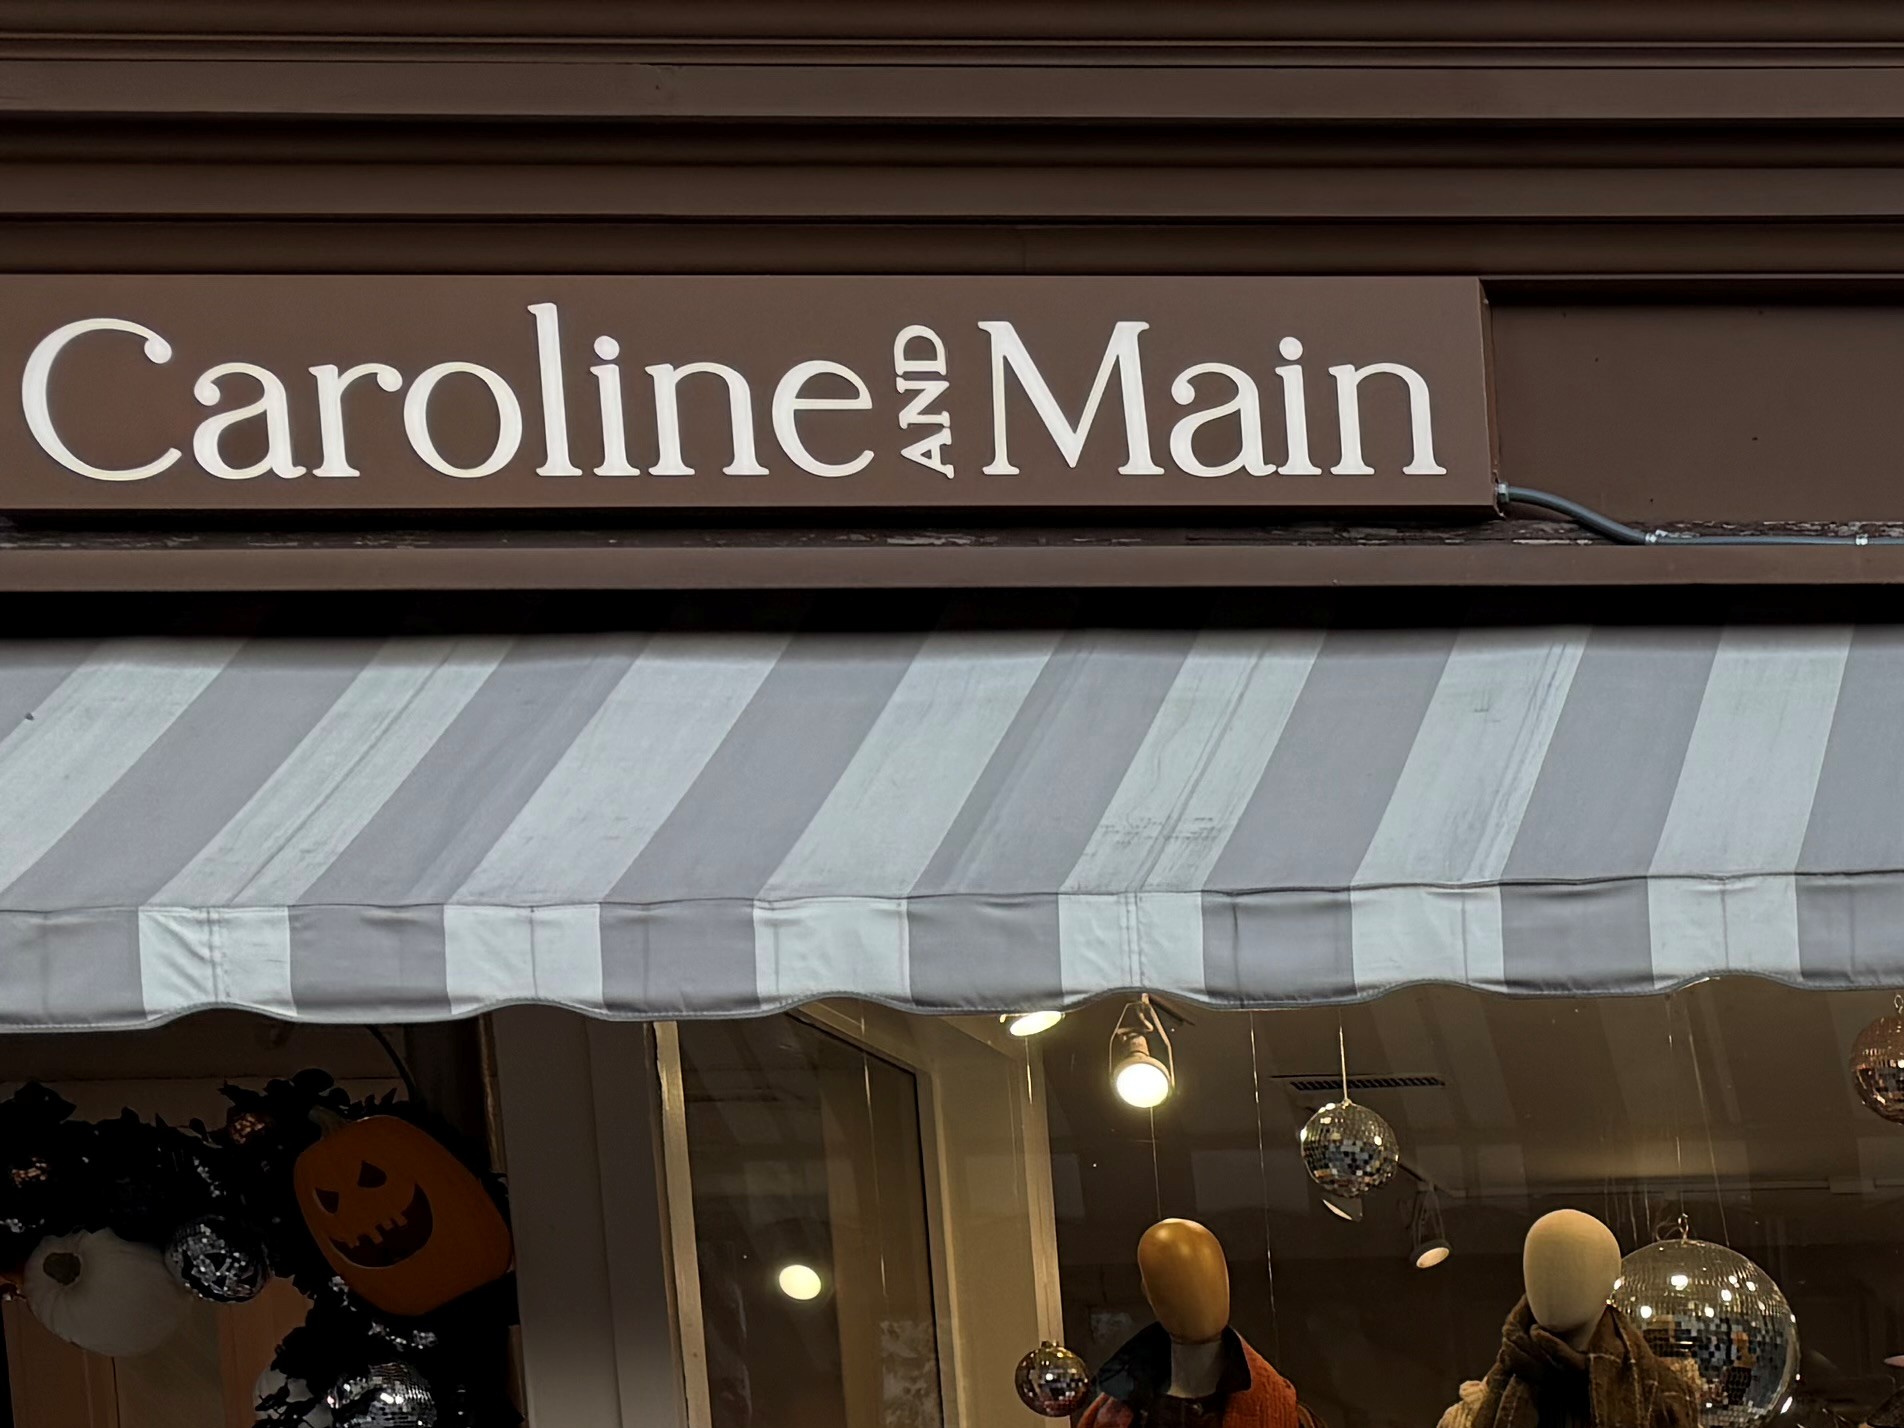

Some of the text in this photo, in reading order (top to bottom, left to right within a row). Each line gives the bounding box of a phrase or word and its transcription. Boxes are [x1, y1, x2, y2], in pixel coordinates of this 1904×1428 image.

[22, 303, 1446, 481] Caroline AND Main
